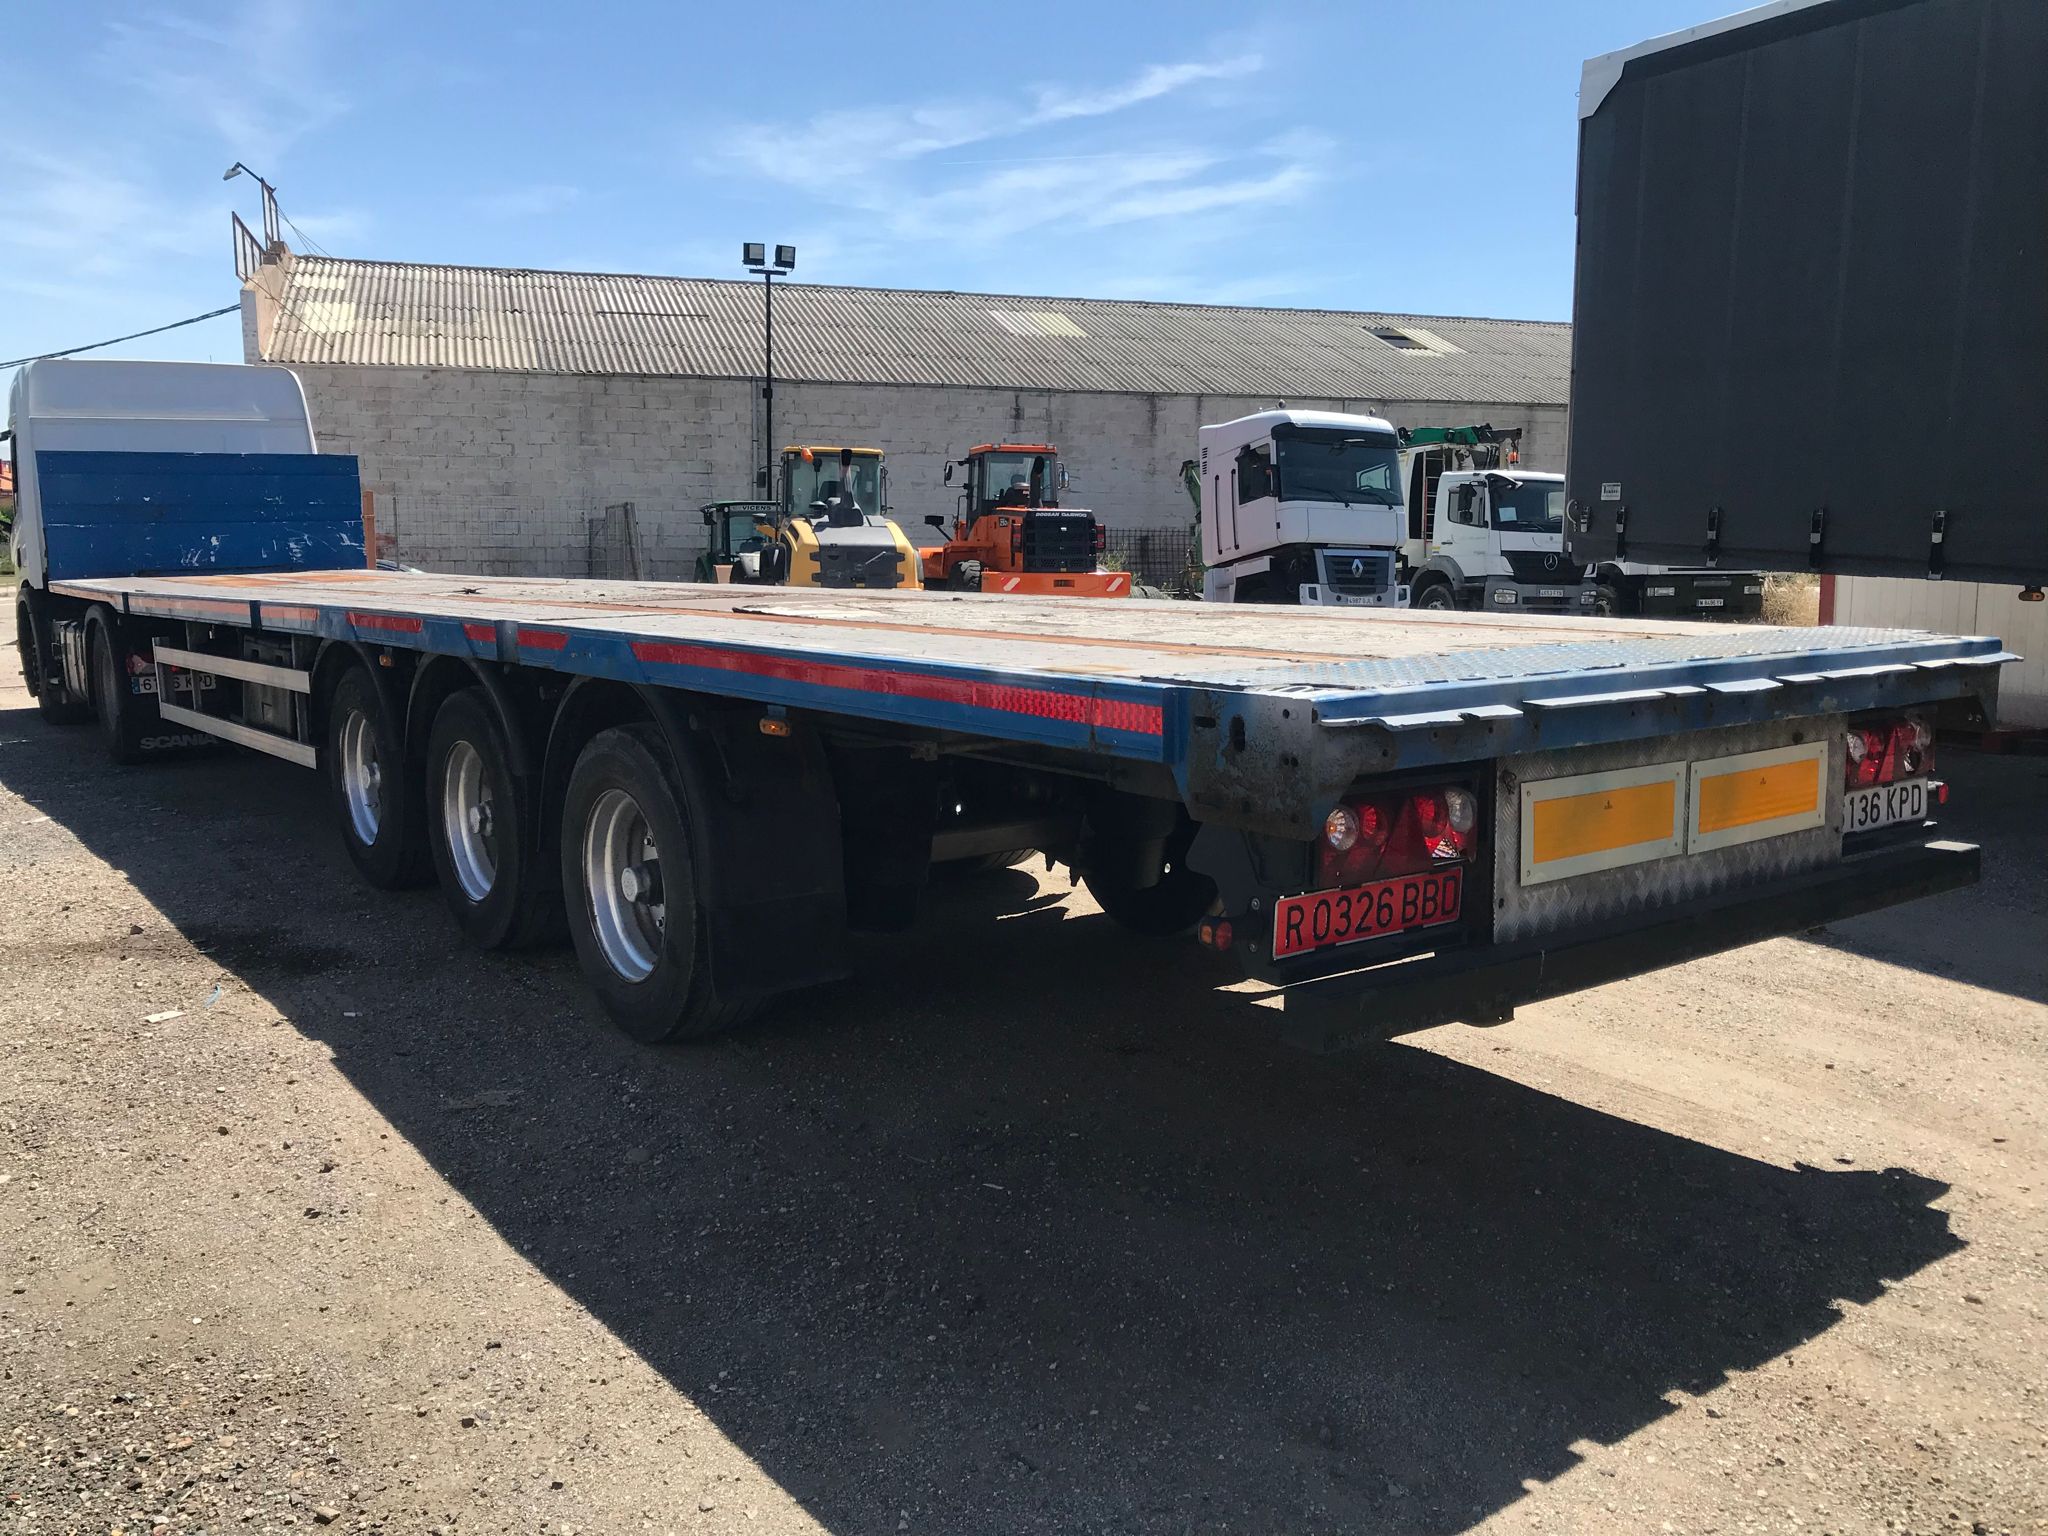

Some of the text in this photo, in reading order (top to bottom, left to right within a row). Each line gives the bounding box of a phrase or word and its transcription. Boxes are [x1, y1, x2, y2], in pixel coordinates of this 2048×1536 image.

[143, 674, 212, 691] 616 KD
[140, 734, 218, 749] SCANIA
[1843, 784, 1922, 829] 136 KPD
